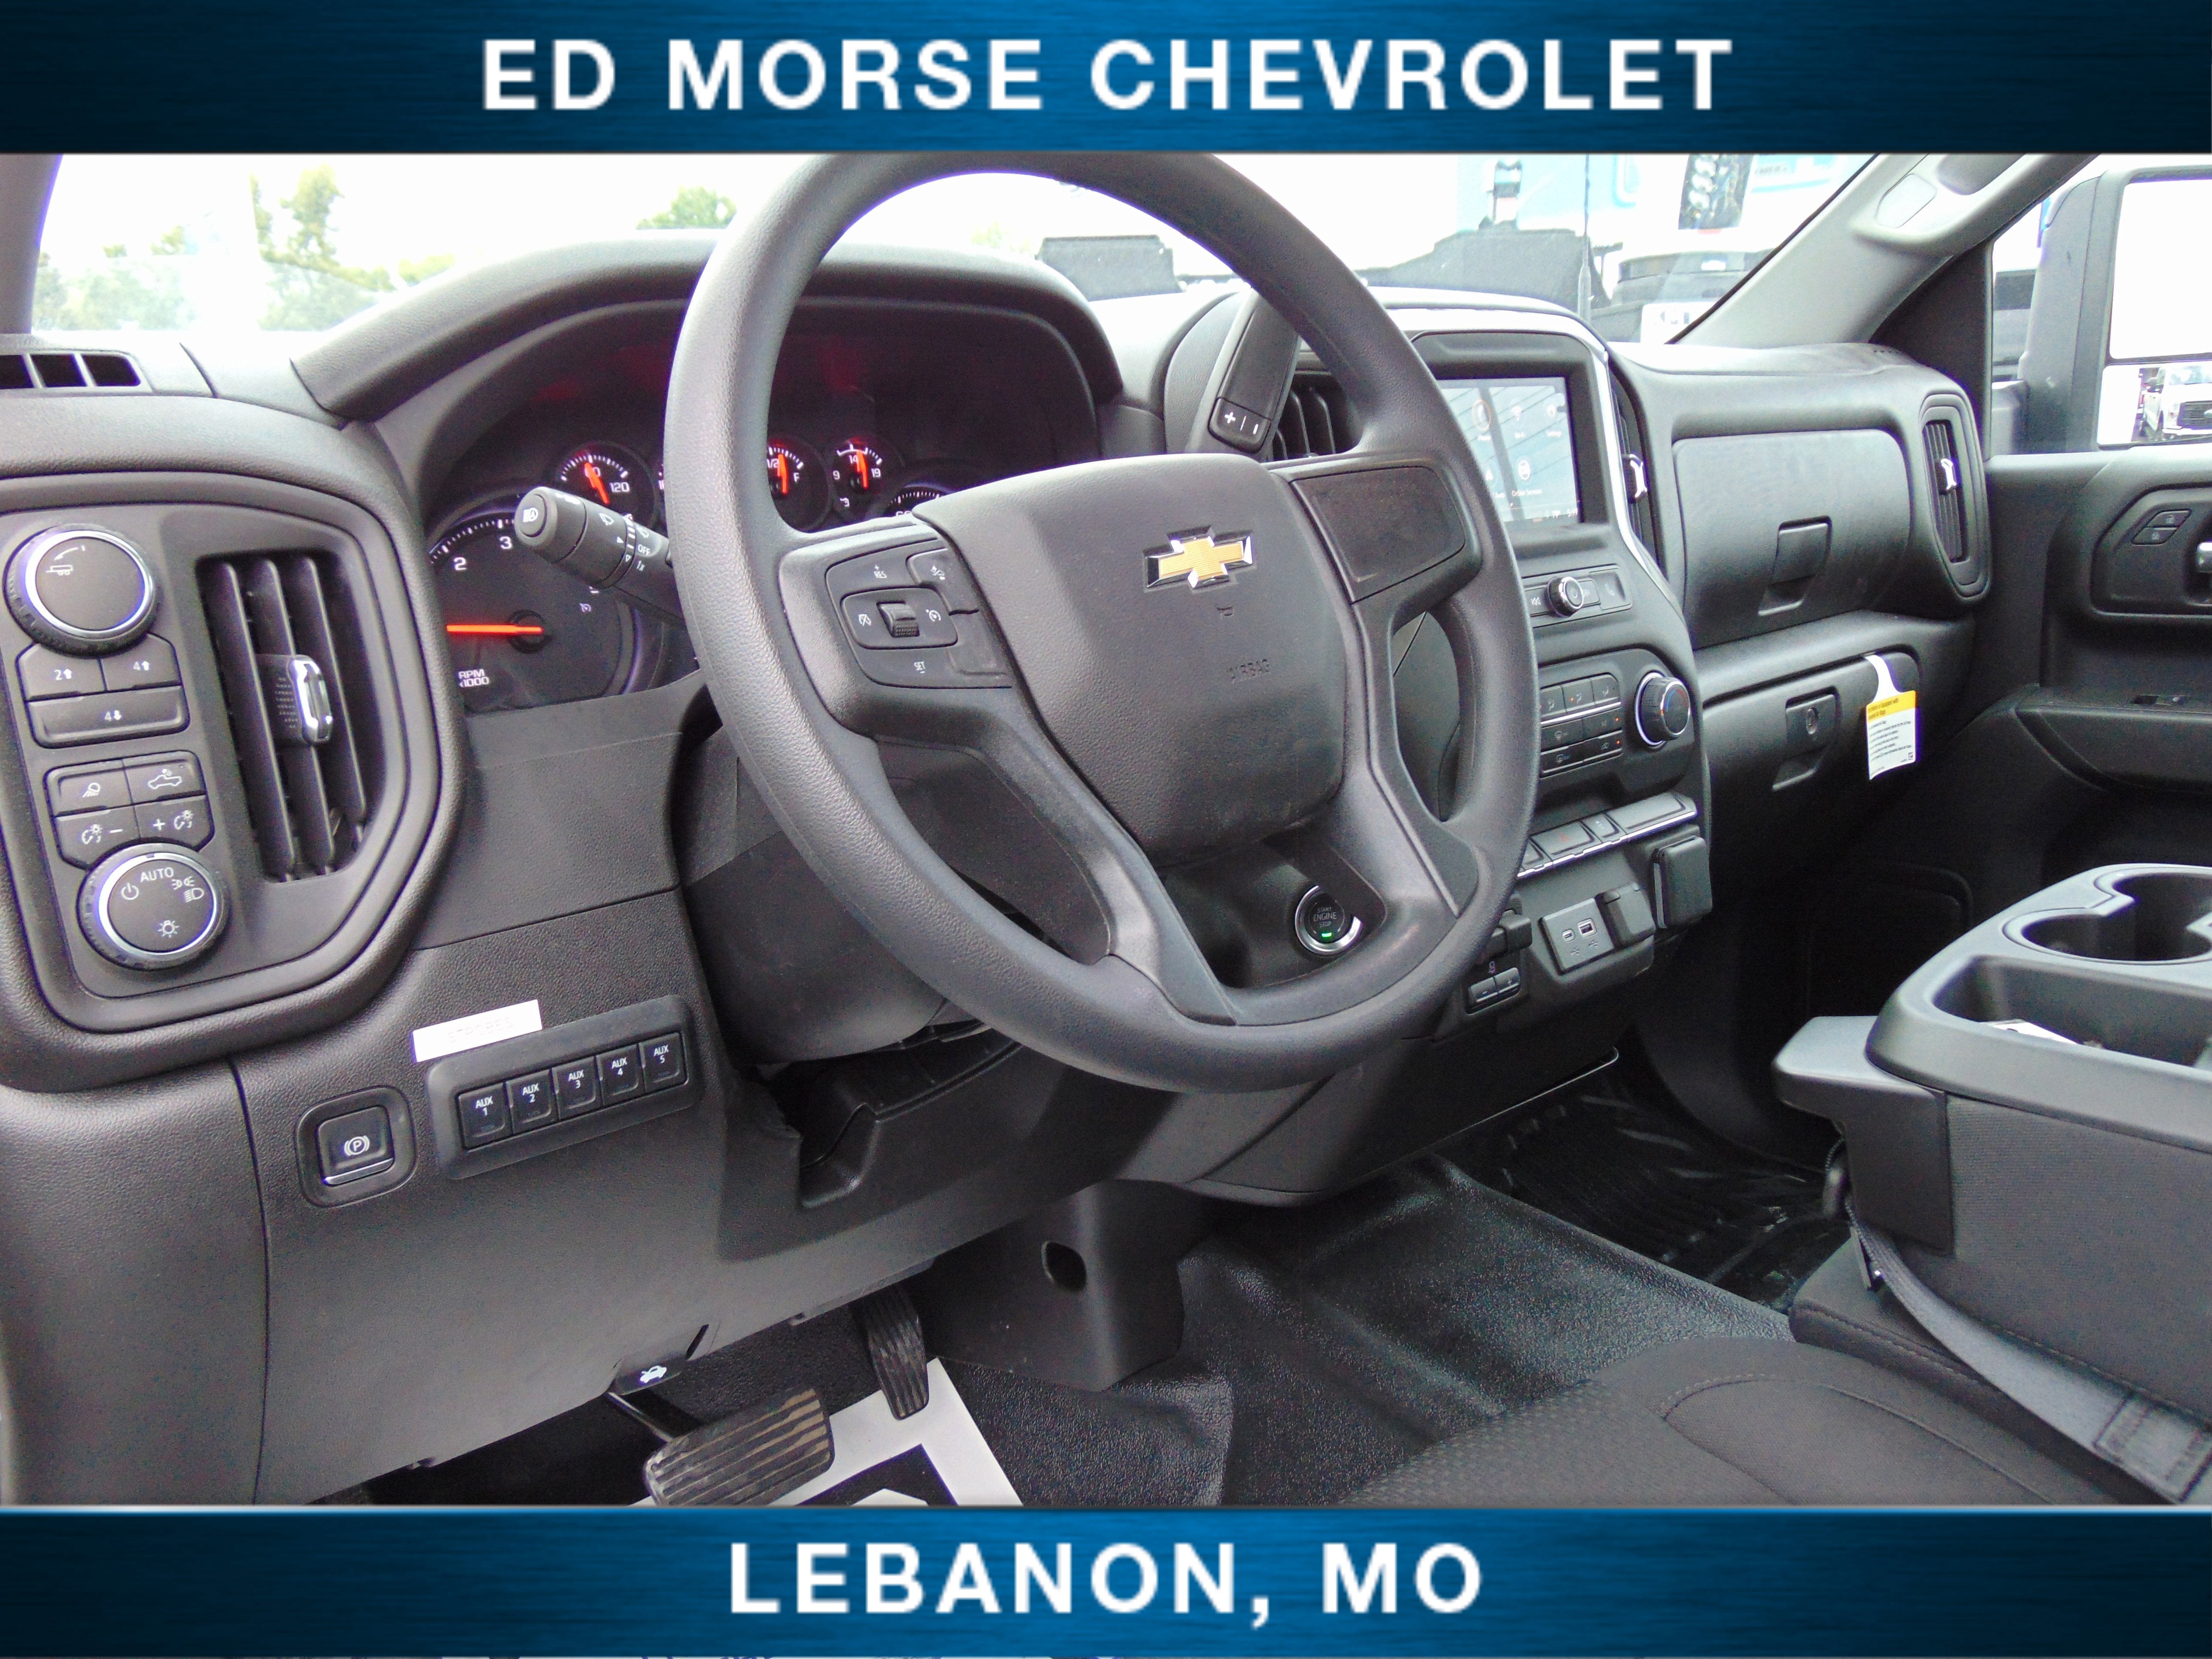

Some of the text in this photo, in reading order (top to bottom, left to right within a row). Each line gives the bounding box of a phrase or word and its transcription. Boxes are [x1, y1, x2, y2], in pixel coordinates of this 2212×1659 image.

[793, 472, 800, 482] F
[833, 470, 840, 480] 9
[871, 468, 881, 478] 19
[609, 481, 630, 493] 120
[499, 536, 513, 549] 3
[638, 544, 650, 555] OFF
[453, 557, 467, 571] 2
[133, 661, 141, 671] 4
[54, 669, 63, 681] 2
[458, 668, 485, 679] RPM
[104, 711, 112, 721] 4
[140, 867, 174, 883] AUTO
[1313, 912, 1337, 921] ENGINE
[654, 1045, 669, 1056] AUX
[611, 1057, 628, 1069] AUX
[660, 1054, 665, 1063] 5
[568, 1070, 584, 1081] AUX
[522, 1083, 540, 1096] AUX
[575, 1080, 581, 1089] 3
[475, 1096, 494, 1109] AUX
[529, 1094, 536, 1103] 2
[483, 1108, 488, 1116] 1
